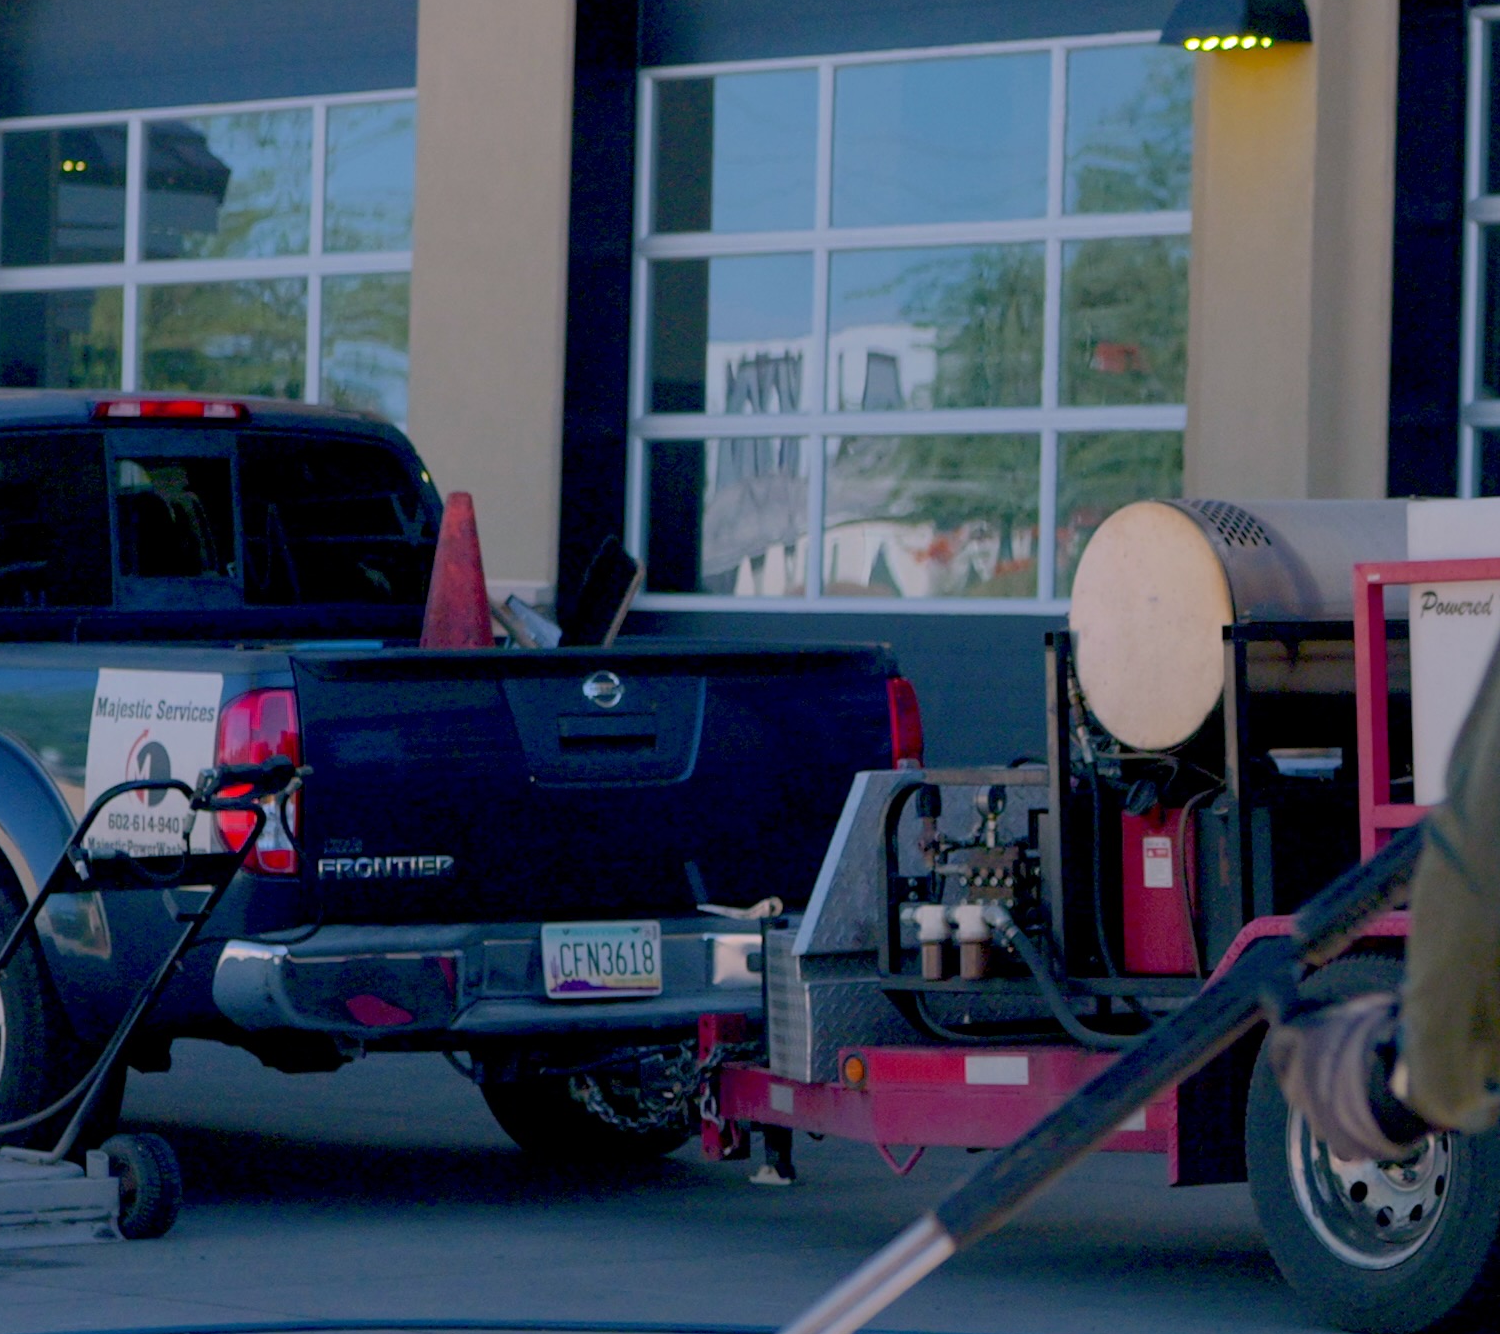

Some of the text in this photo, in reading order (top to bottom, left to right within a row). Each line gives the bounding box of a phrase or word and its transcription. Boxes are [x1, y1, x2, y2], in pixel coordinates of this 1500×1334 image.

[1420, 590, 1494, 619] Powered
[95, 696, 215, 723] Majestic Services
[318, 855, 454, 880] FRONTIER
[560, 940, 655, 977] CFN3618
